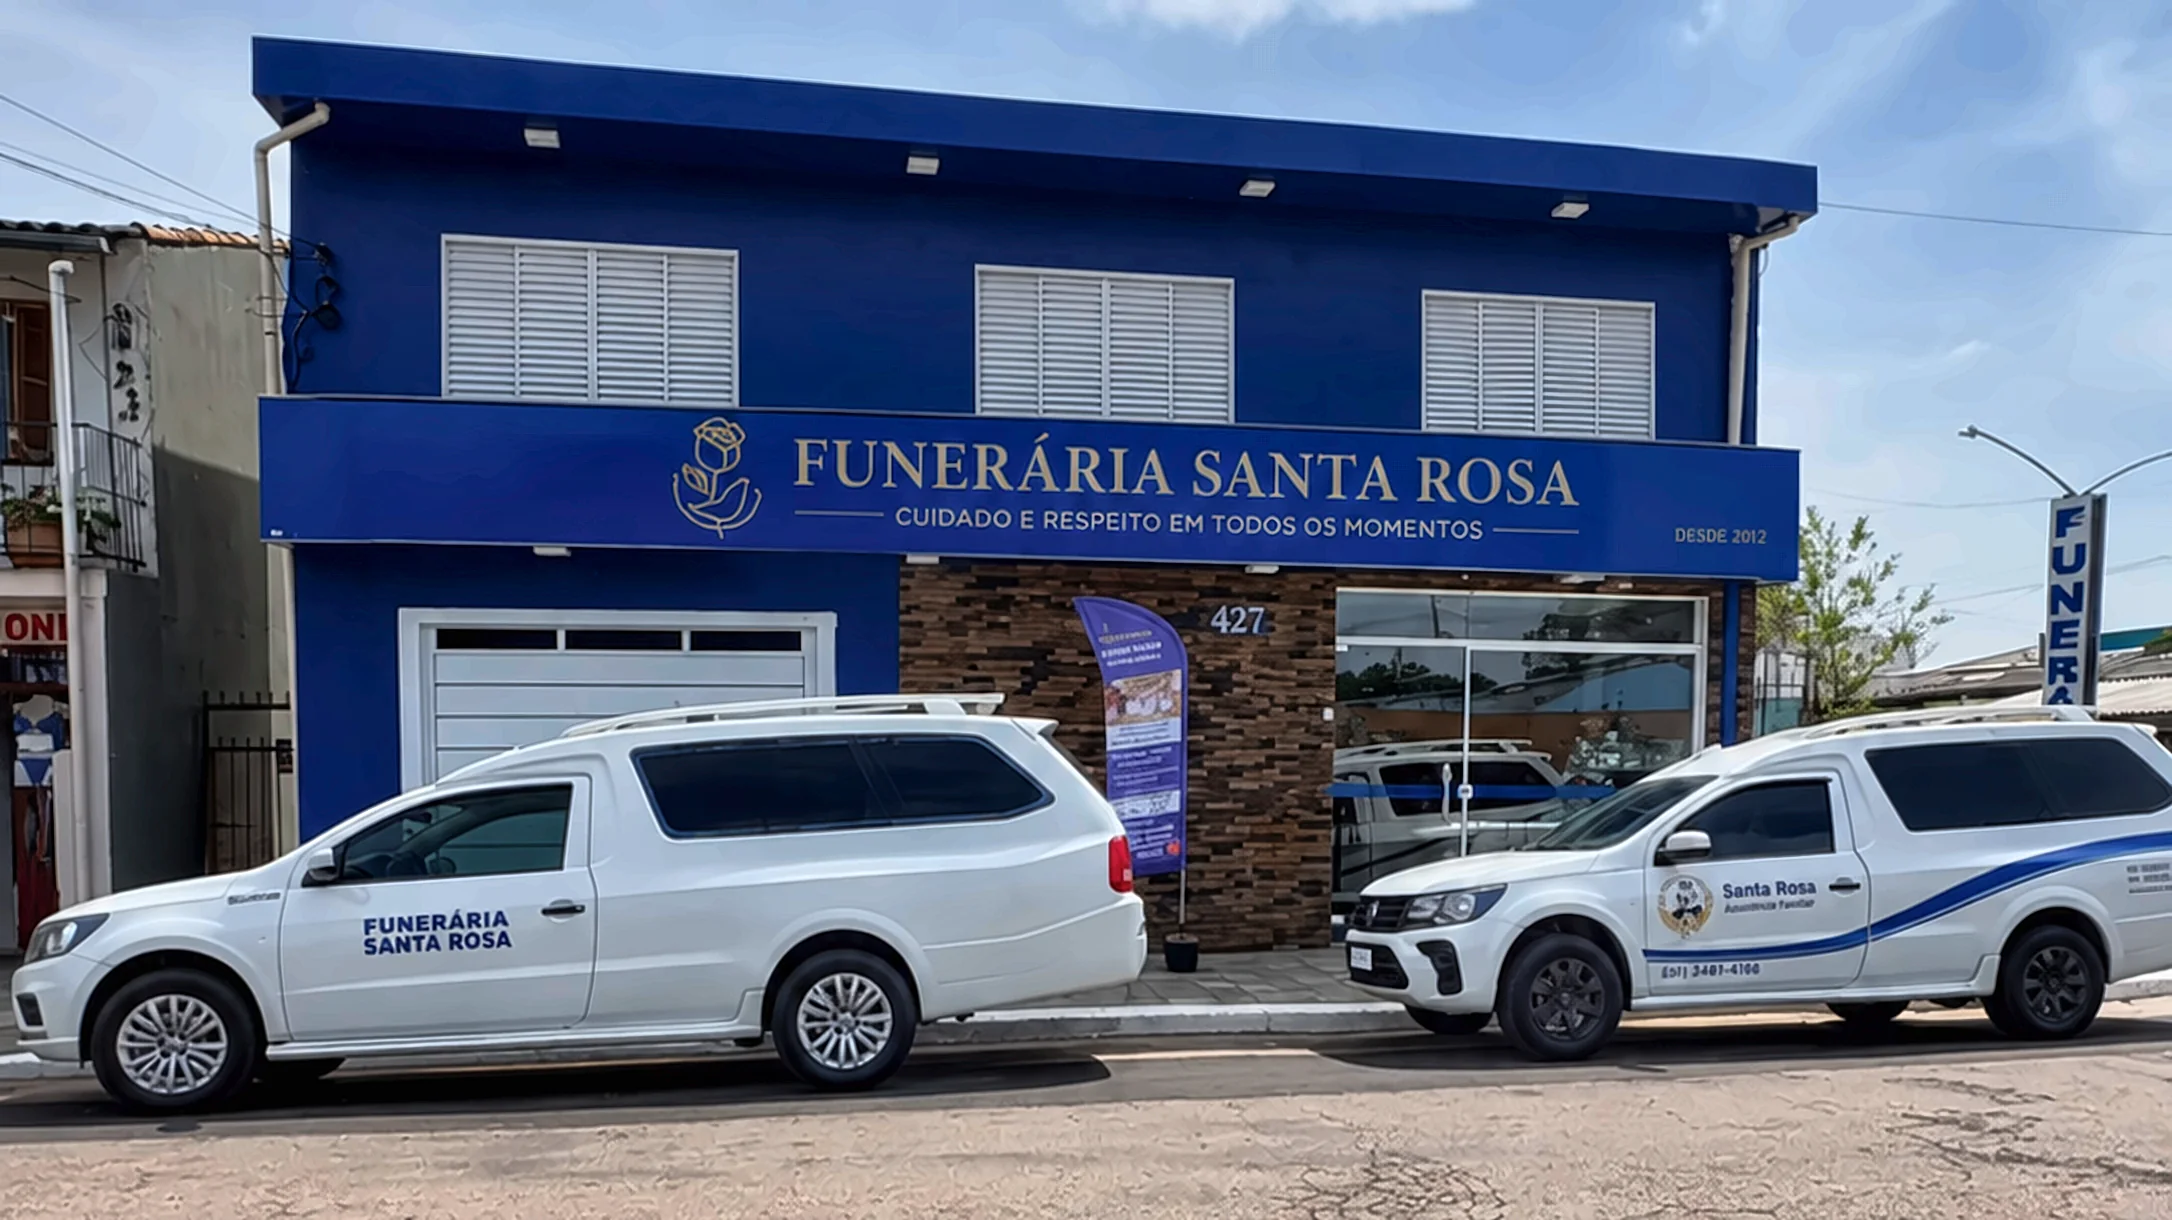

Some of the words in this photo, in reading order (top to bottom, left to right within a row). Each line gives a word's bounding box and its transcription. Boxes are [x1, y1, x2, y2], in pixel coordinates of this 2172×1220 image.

[795, 432, 1174, 495] FUNERÁRIA
[1192, 450, 1397, 501] SANTA
[1417, 457, 1580, 506] ROSA
[896, 507, 1012, 528] CUIDADO
[1021, 510, 1034, 529] E
[1044, 511, 1161, 532] RESPEITO
[1170, 514, 1203, 533] EM
[1212, 515, 1296, 536] TODOS
[1304, 517, 1336, 537] OS
[1345, 518, 1483, 540] MOMENTOS
[1675, 527, 1728, 544] DESDE
[1731, 529, 1767, 545] 2012
[1210, 604, 1265, 634] 427
[1722, 882, 1771, 899] Santa
[1775, 880, 1817, 896] Rosa
[363, 908, 510, 936] FUNERÁRIA
[363, 934, 442, 956] SANTA
[448, 930, 513, 951] ROSA
